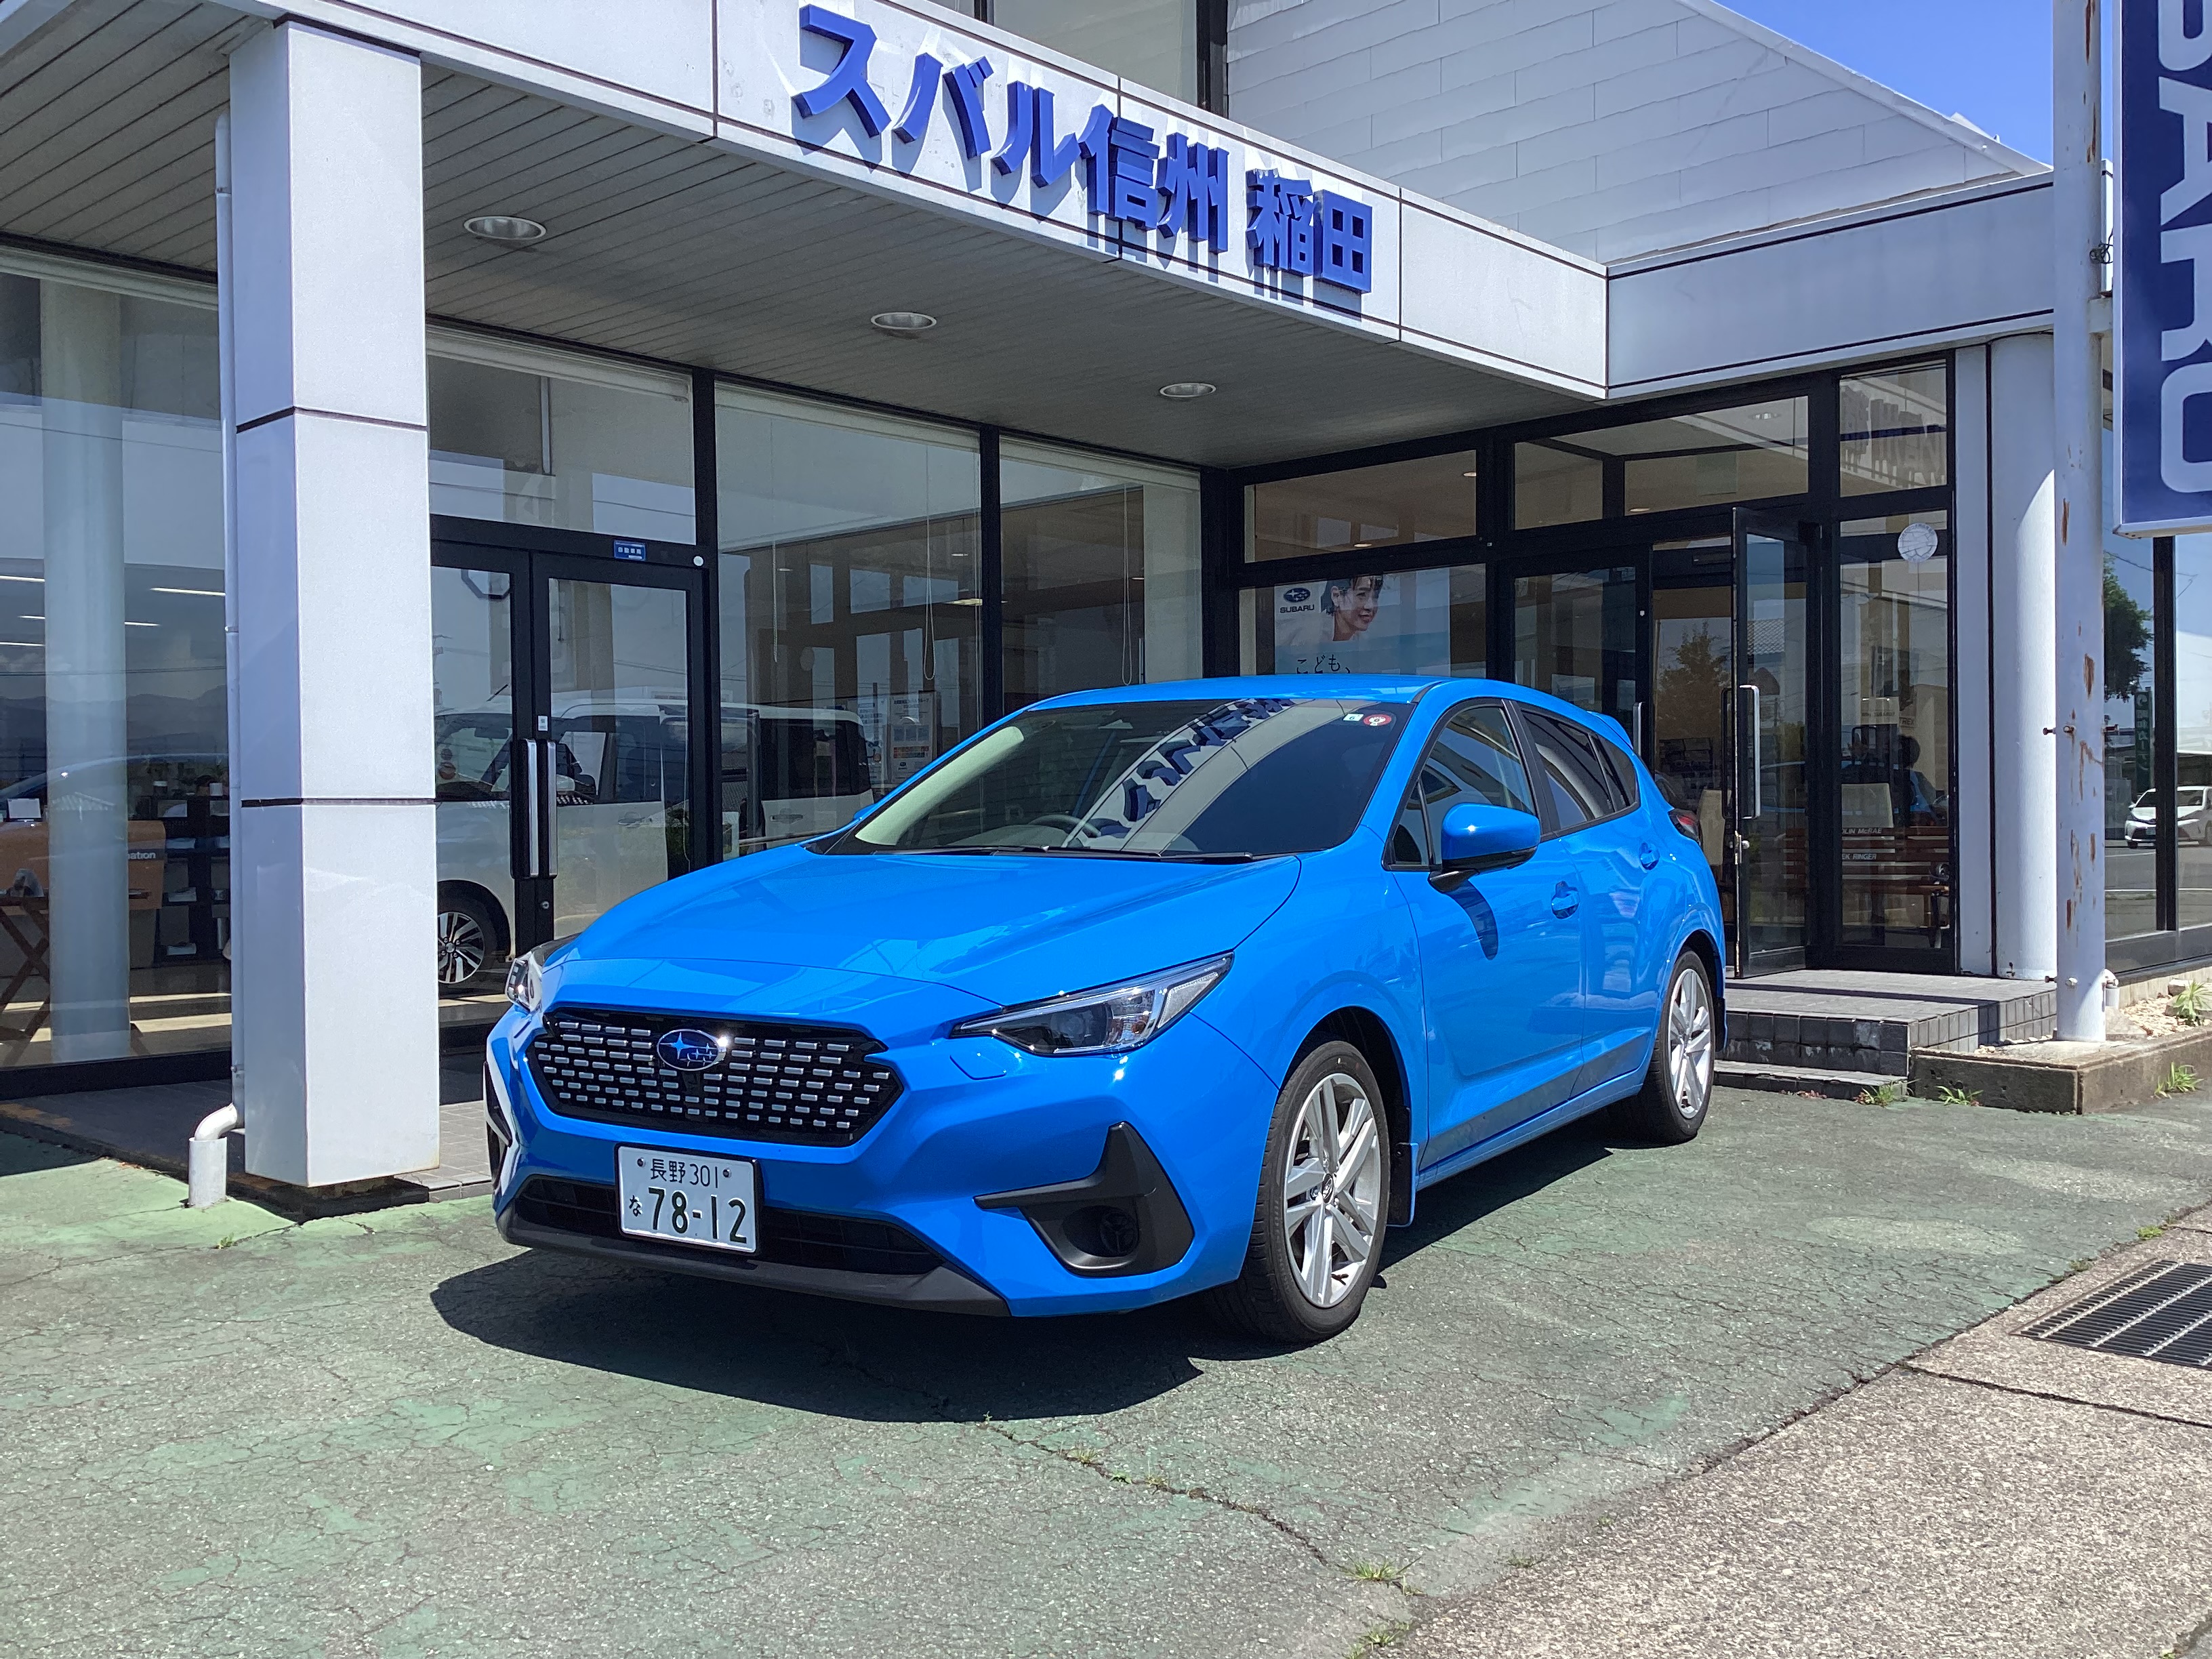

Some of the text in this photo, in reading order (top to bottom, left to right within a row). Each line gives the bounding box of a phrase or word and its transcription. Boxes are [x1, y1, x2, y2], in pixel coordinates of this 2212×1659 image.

[792, 4, 1372, 294] スバル信州 稲田
[1279, 604, 1315, 613] SUBARU
[127, 851, 156, 859] ation
[628, 1187, 747, 1244] な 78-12
